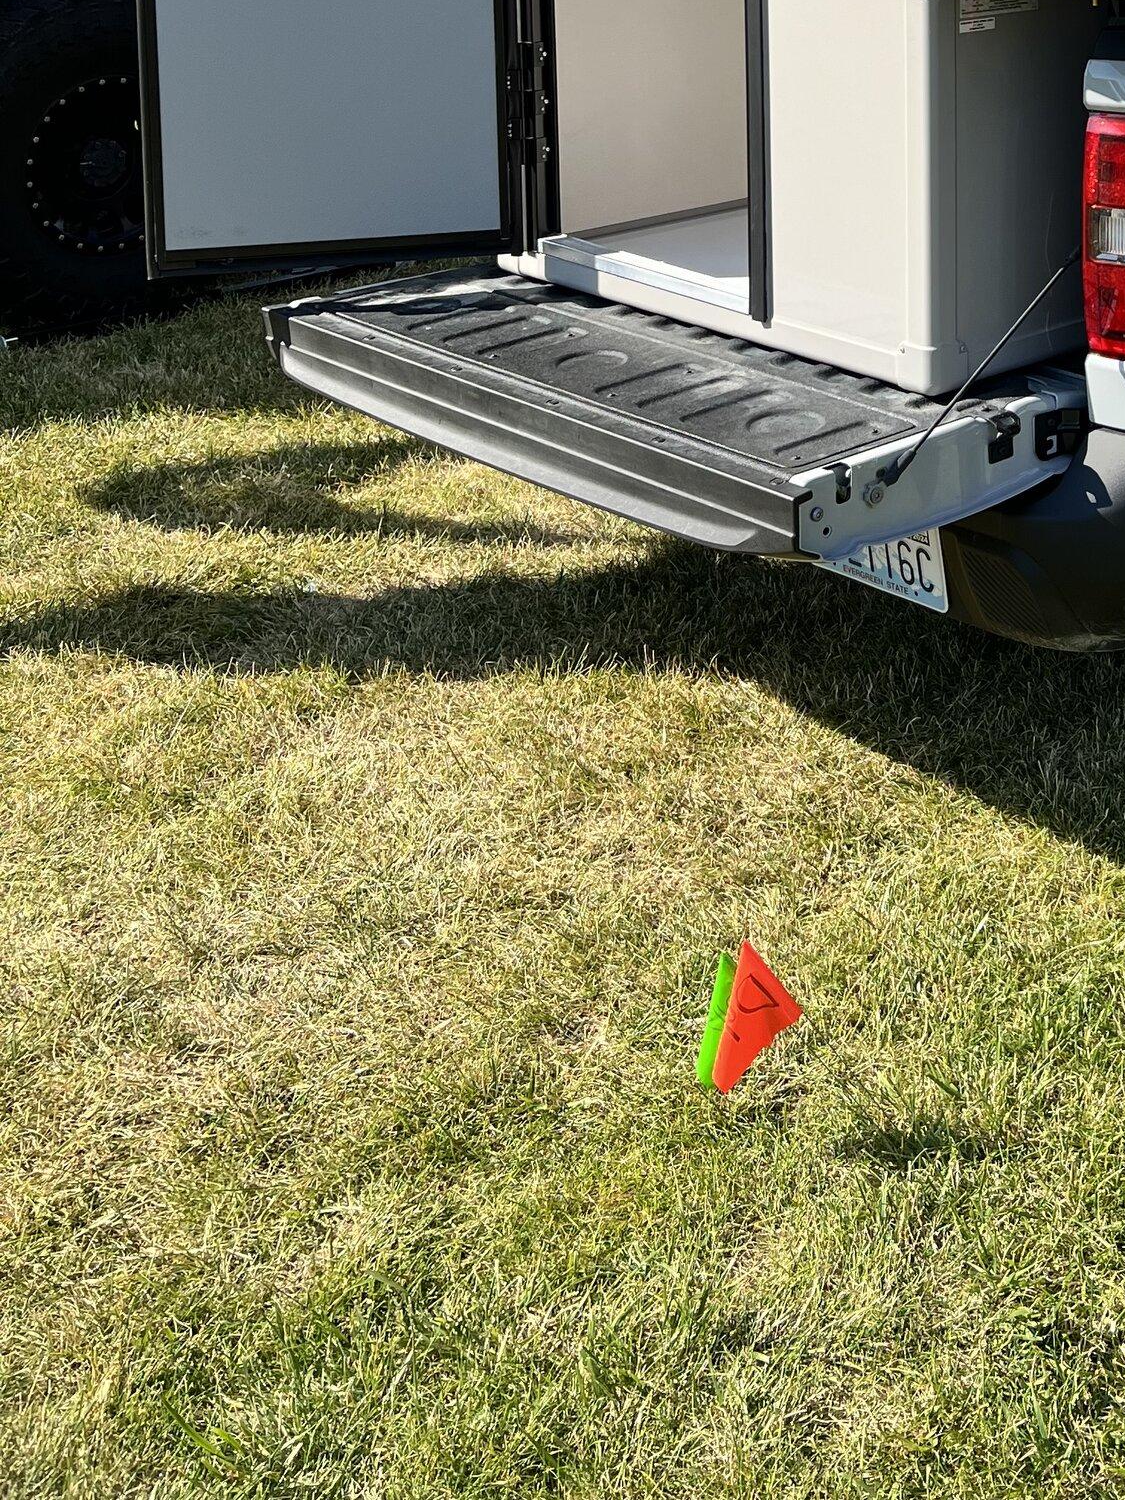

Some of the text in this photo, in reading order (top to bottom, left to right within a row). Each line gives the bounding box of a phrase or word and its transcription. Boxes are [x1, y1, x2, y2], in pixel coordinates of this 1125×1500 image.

[843, 564, 909, 595] EVERGREEN STATE
[849, 540, 934, 593] 116C
